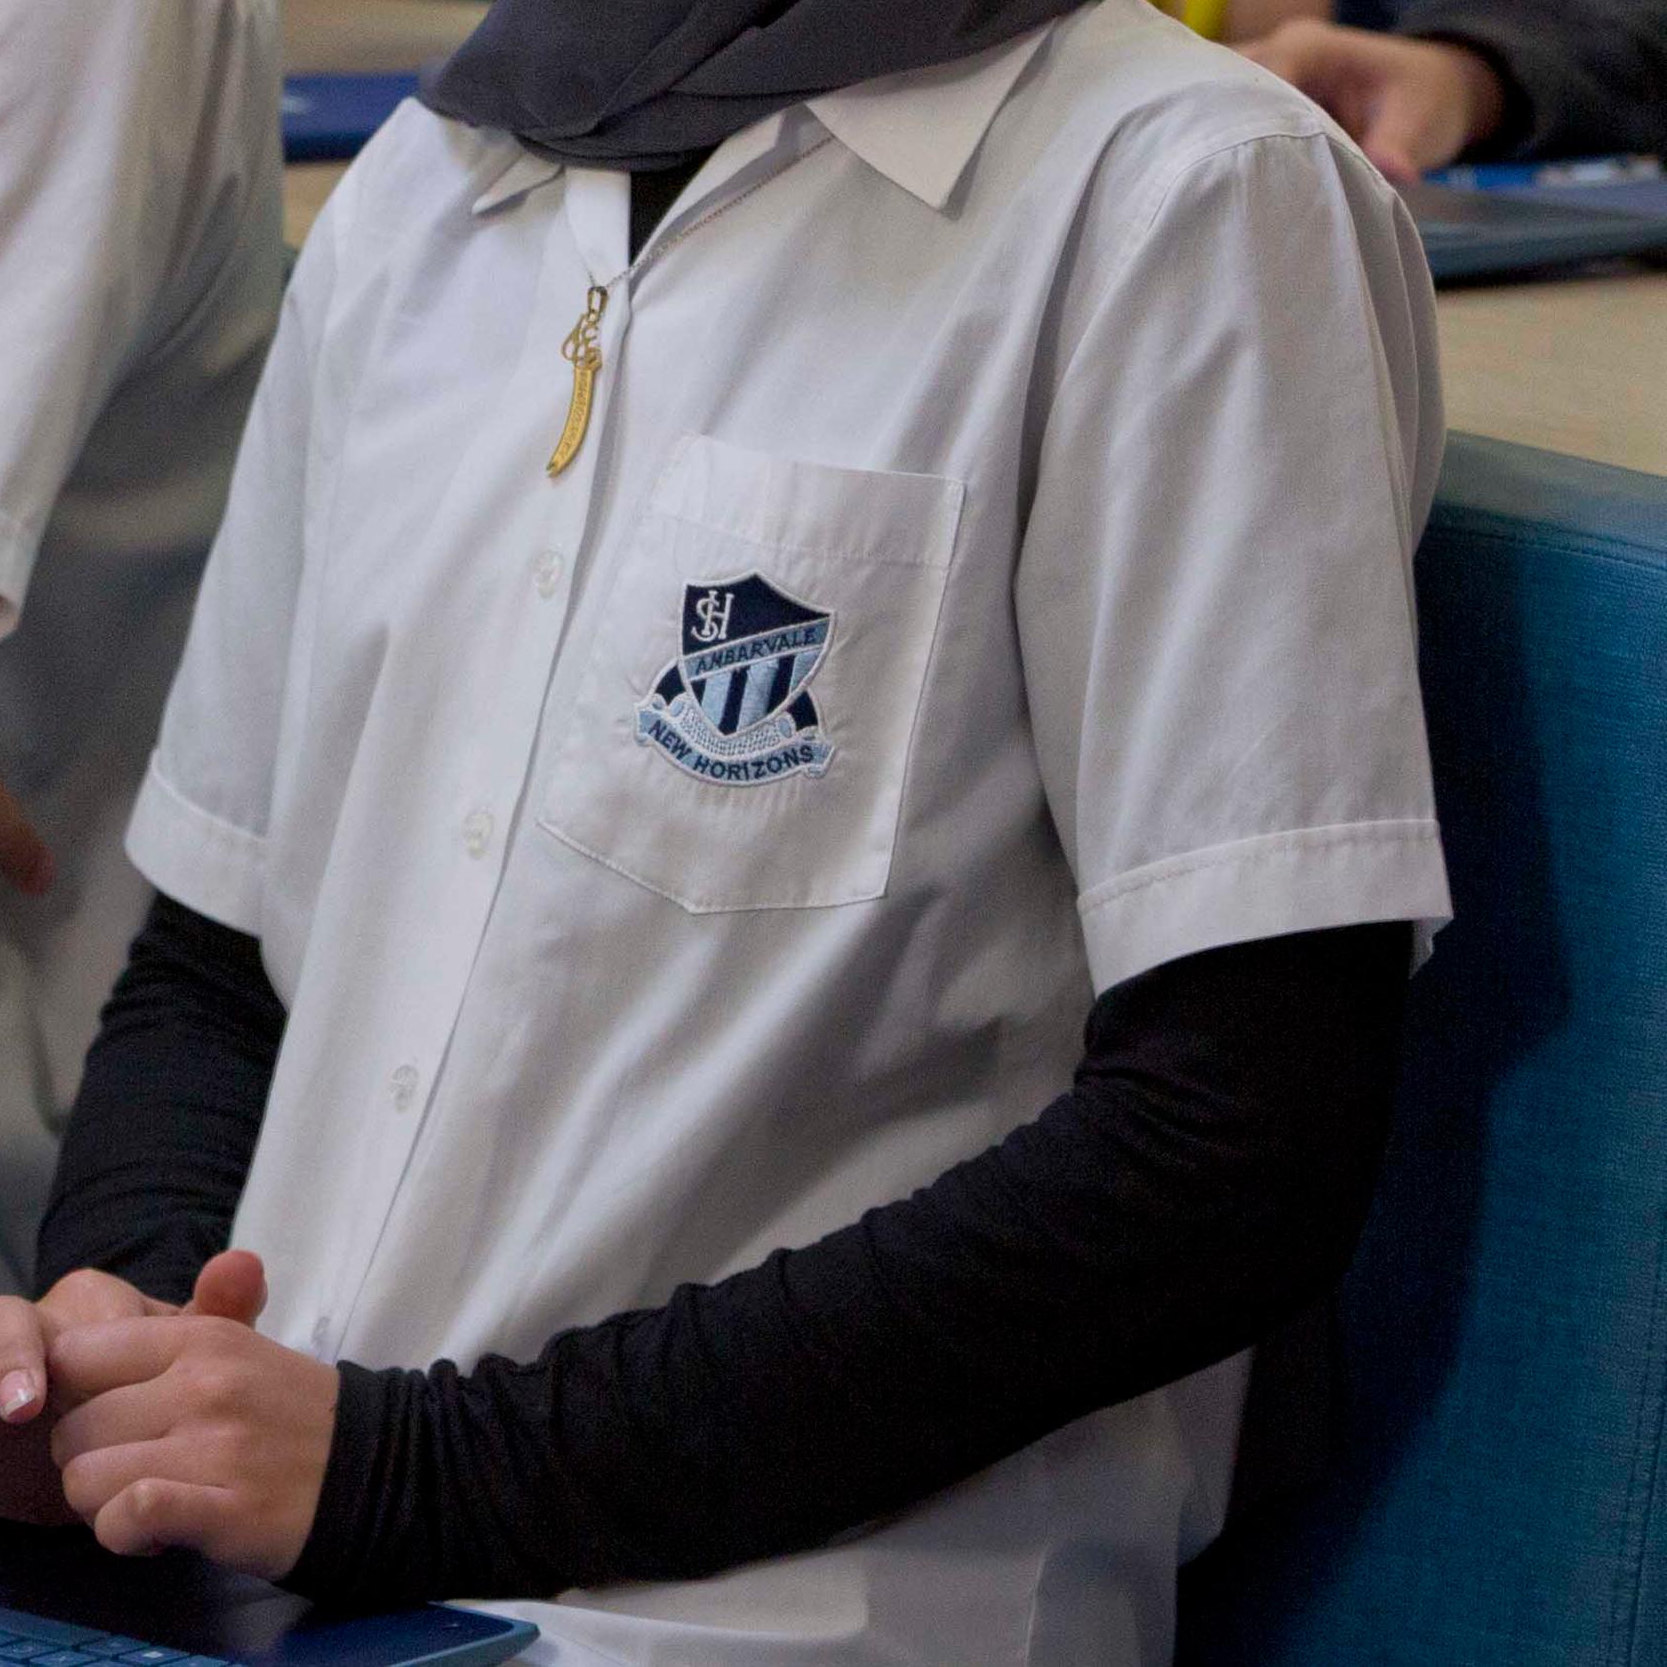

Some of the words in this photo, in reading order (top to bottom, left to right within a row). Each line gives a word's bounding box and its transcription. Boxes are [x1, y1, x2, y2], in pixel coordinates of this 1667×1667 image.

[696, 628, 816, 674] AMBARVALE
[647, 719, 692, 760] NEW
[692, 744, 815, 780] HORIZONS
